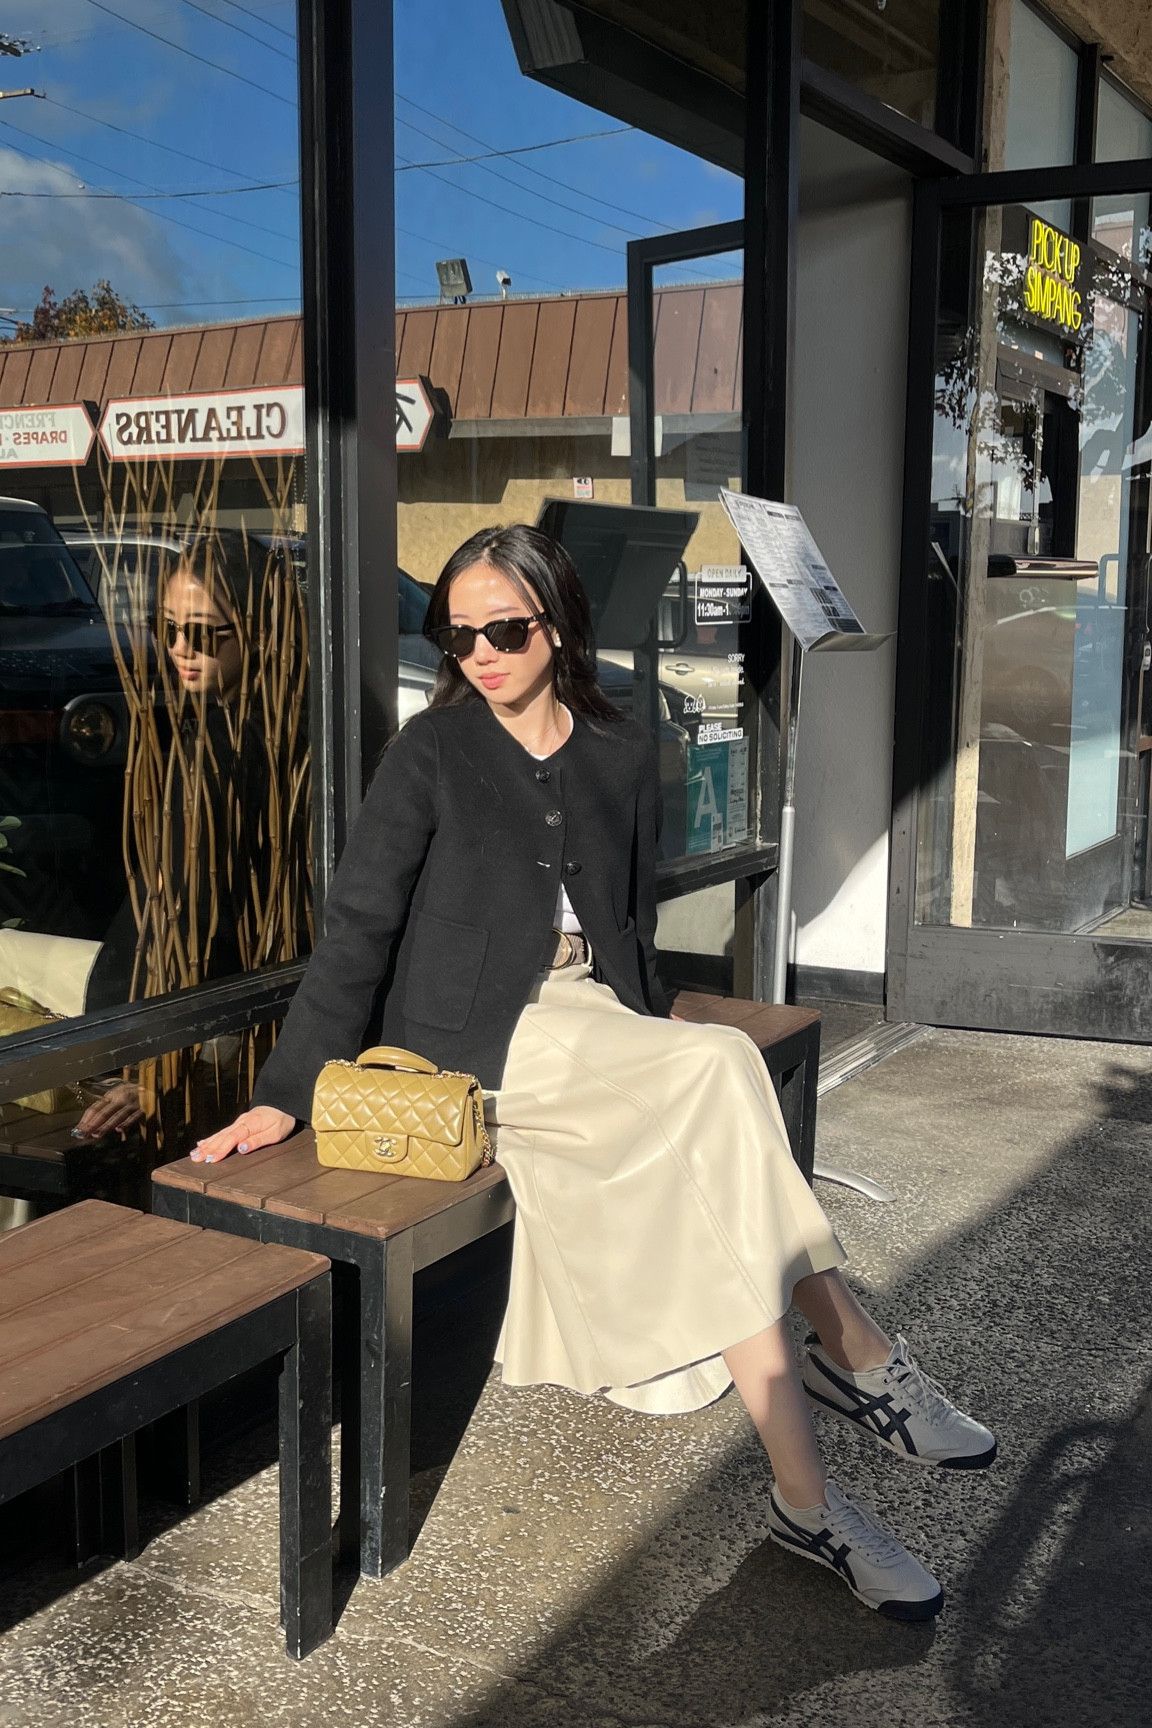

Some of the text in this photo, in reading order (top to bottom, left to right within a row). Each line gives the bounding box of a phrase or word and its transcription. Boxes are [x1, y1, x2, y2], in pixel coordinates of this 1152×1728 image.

[1030, 219, 1080, 283] PICK UP
[1023, 266, 1082, 330] SIMPANG
[707, 568, 742, 578] OPEN DAILY
[727, 653, 745, 663] SORRY
[698, 722, 722, 733] PLEASE
[699, 729, 742, 743] NO SOLICITING
[693, 766, 718, 829] A
